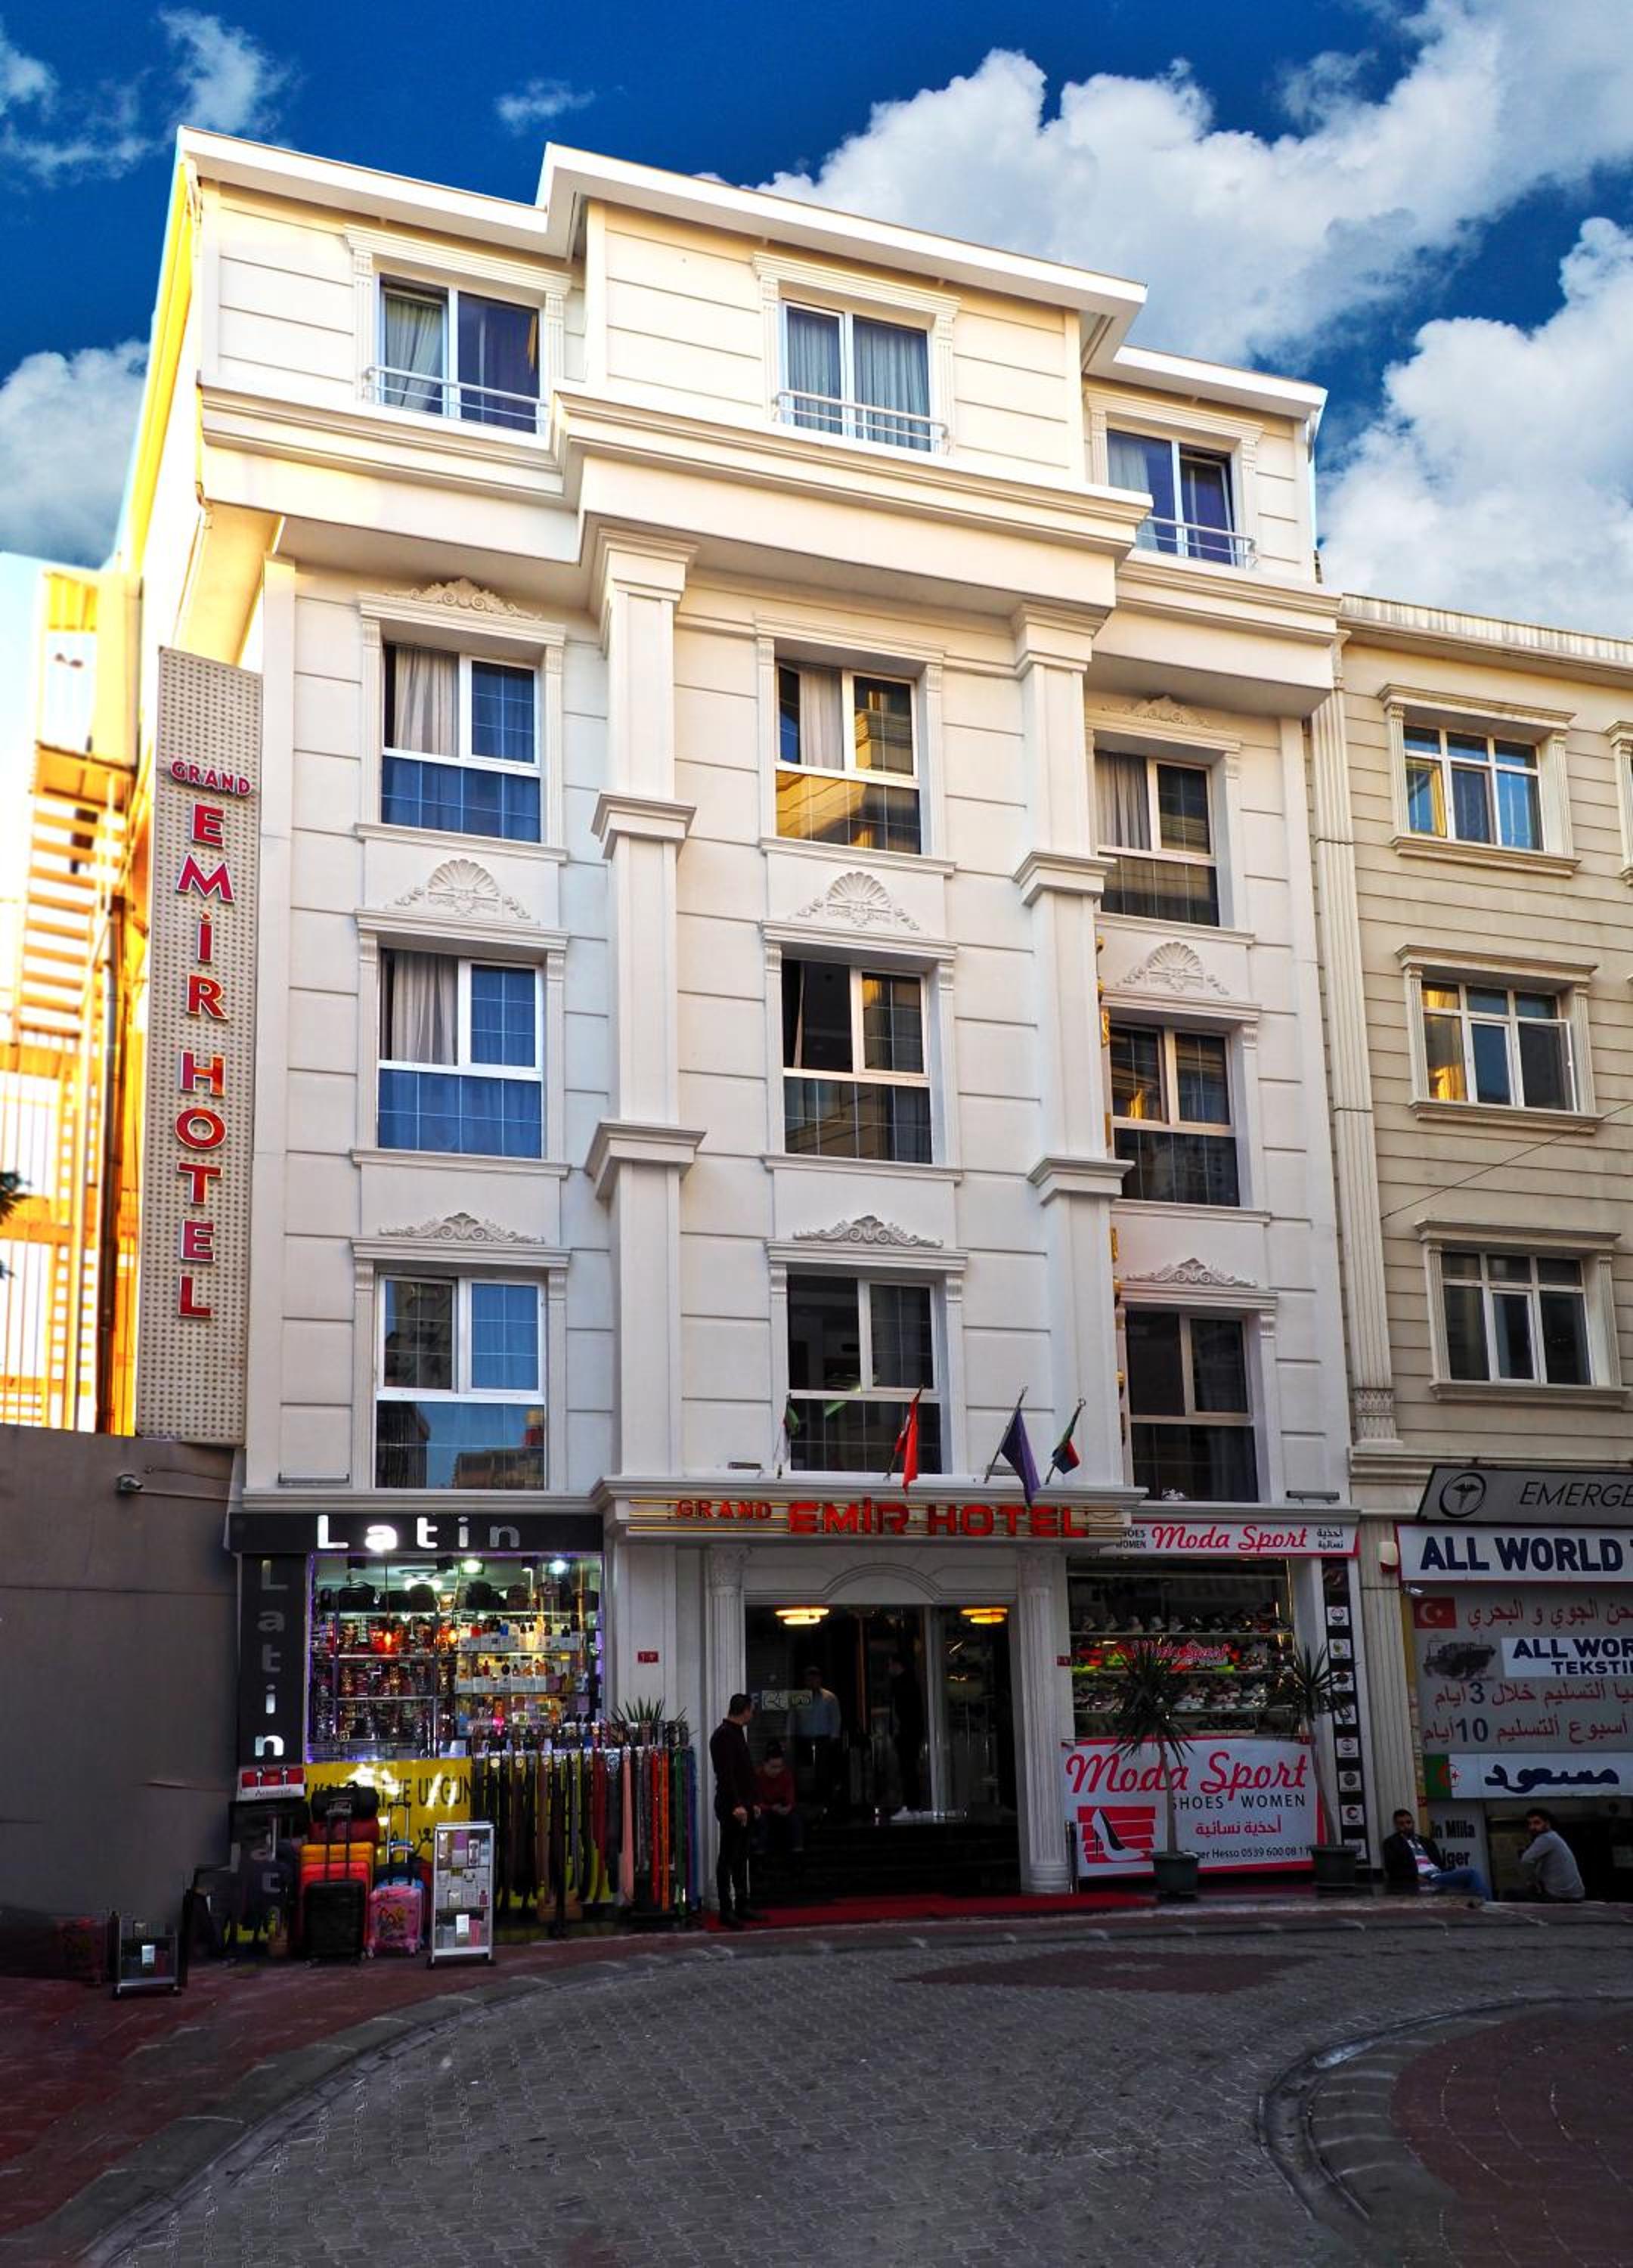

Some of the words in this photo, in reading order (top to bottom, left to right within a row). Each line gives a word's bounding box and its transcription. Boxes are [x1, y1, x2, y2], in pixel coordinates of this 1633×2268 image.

[171, 761, 252, 796] GRAND
[175, 1050, 227, 1318] HOTEL
[317, 1514, 520, 1551] Latin
[677, 1499, 771, 1519] GRAND
[927, 1504, 1089, 1537] HOTEL
[1151, 1526, 1230, 1549] Moda
[1238, 1524, 1308, 1551] Sport
[1420, 1536, 1490, 1570] ALL
[1494, 1537, 1623, 1572] WORLD
[254, 1559, 288, 1757] Latin
[1512, 1638, 1568, 1659] ALL
[1456, 1717, 1489, 1742] 10
[1066, 1753, 1190, 1794] Moda
[1200, 1751, 1308, 1801] Sport
[1484, 1764, 1619, 1794] مسعود
[1172, 1795, 1224, 1811] SHOES
[1241, 1793, 1306, 1810] WOMEN
[1439, 1848, 1470, 1869] lger
